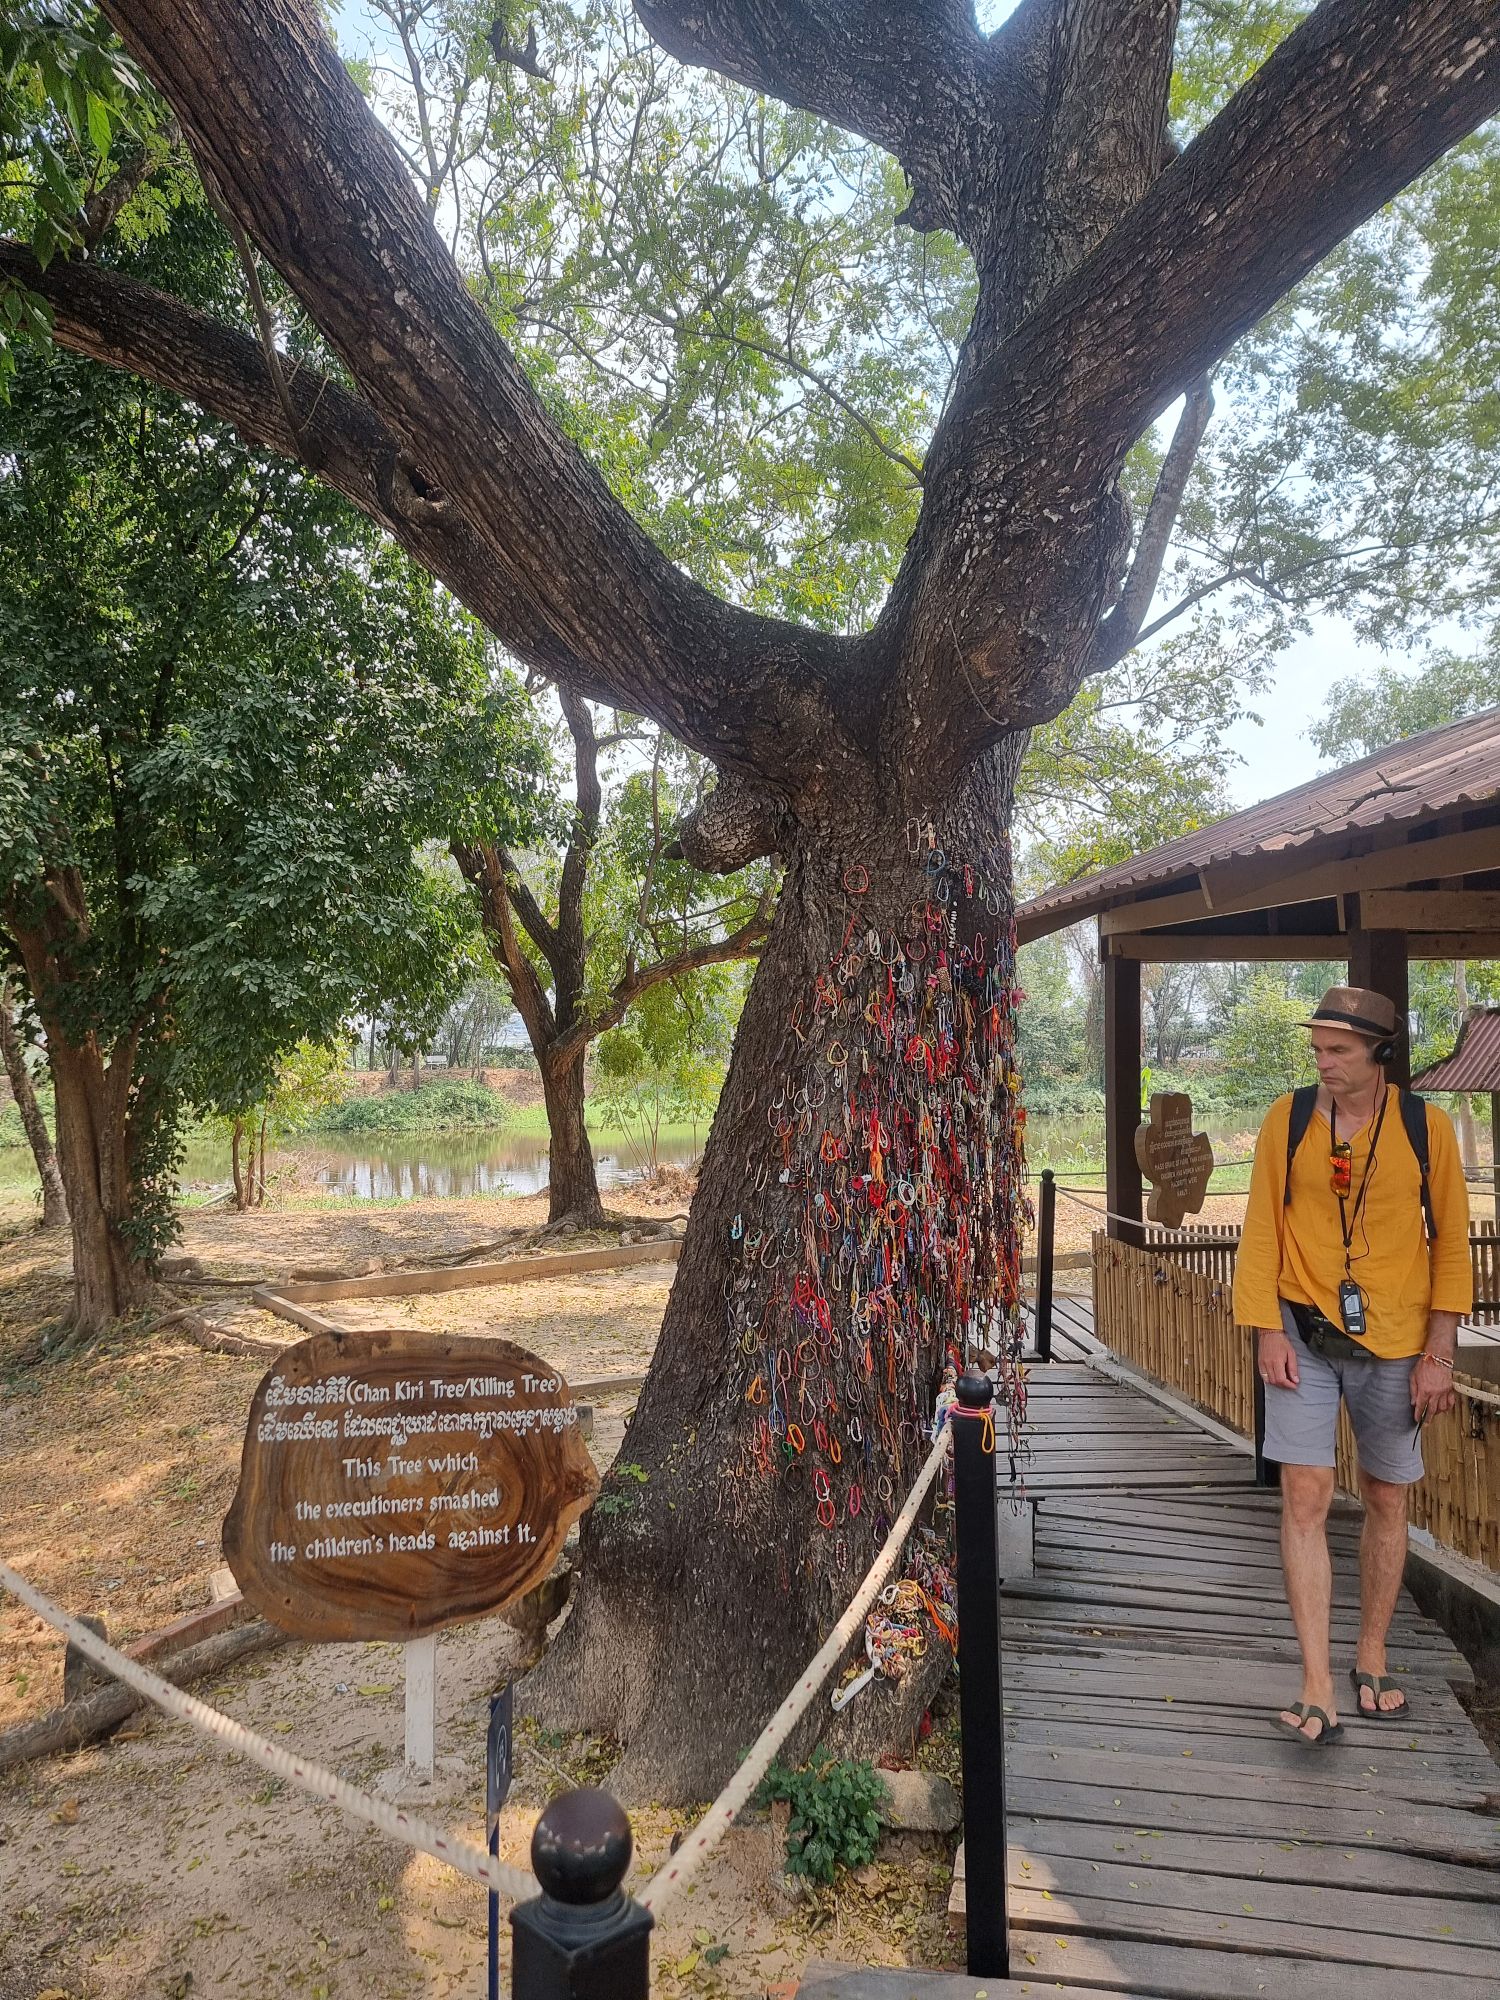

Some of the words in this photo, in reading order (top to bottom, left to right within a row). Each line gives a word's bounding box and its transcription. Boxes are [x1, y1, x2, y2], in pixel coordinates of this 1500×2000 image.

[395, 1381, 424, 1401] Kiri
[430, 1376, 515, 1398] Tree/Killing
[521, 1369, 563, 1393] Tree)
[342, 1457, 381, 1478] This
[388, 1456, 422, 1476] Tree
[428, 1452, 478, 1473] which
[296, 1500, 321, 1521] the
[326, 1494, 423, 1518] executioners
[429, 1489, 499, 1511] smashed
[270, 1542, 296, 1562] the
[305, 1534, 384, 1559] children's
[389, 1531, 435, 1552] heads
[448, 1527, 509, 1551] against
[517, 1524, 537, 1545] it.
